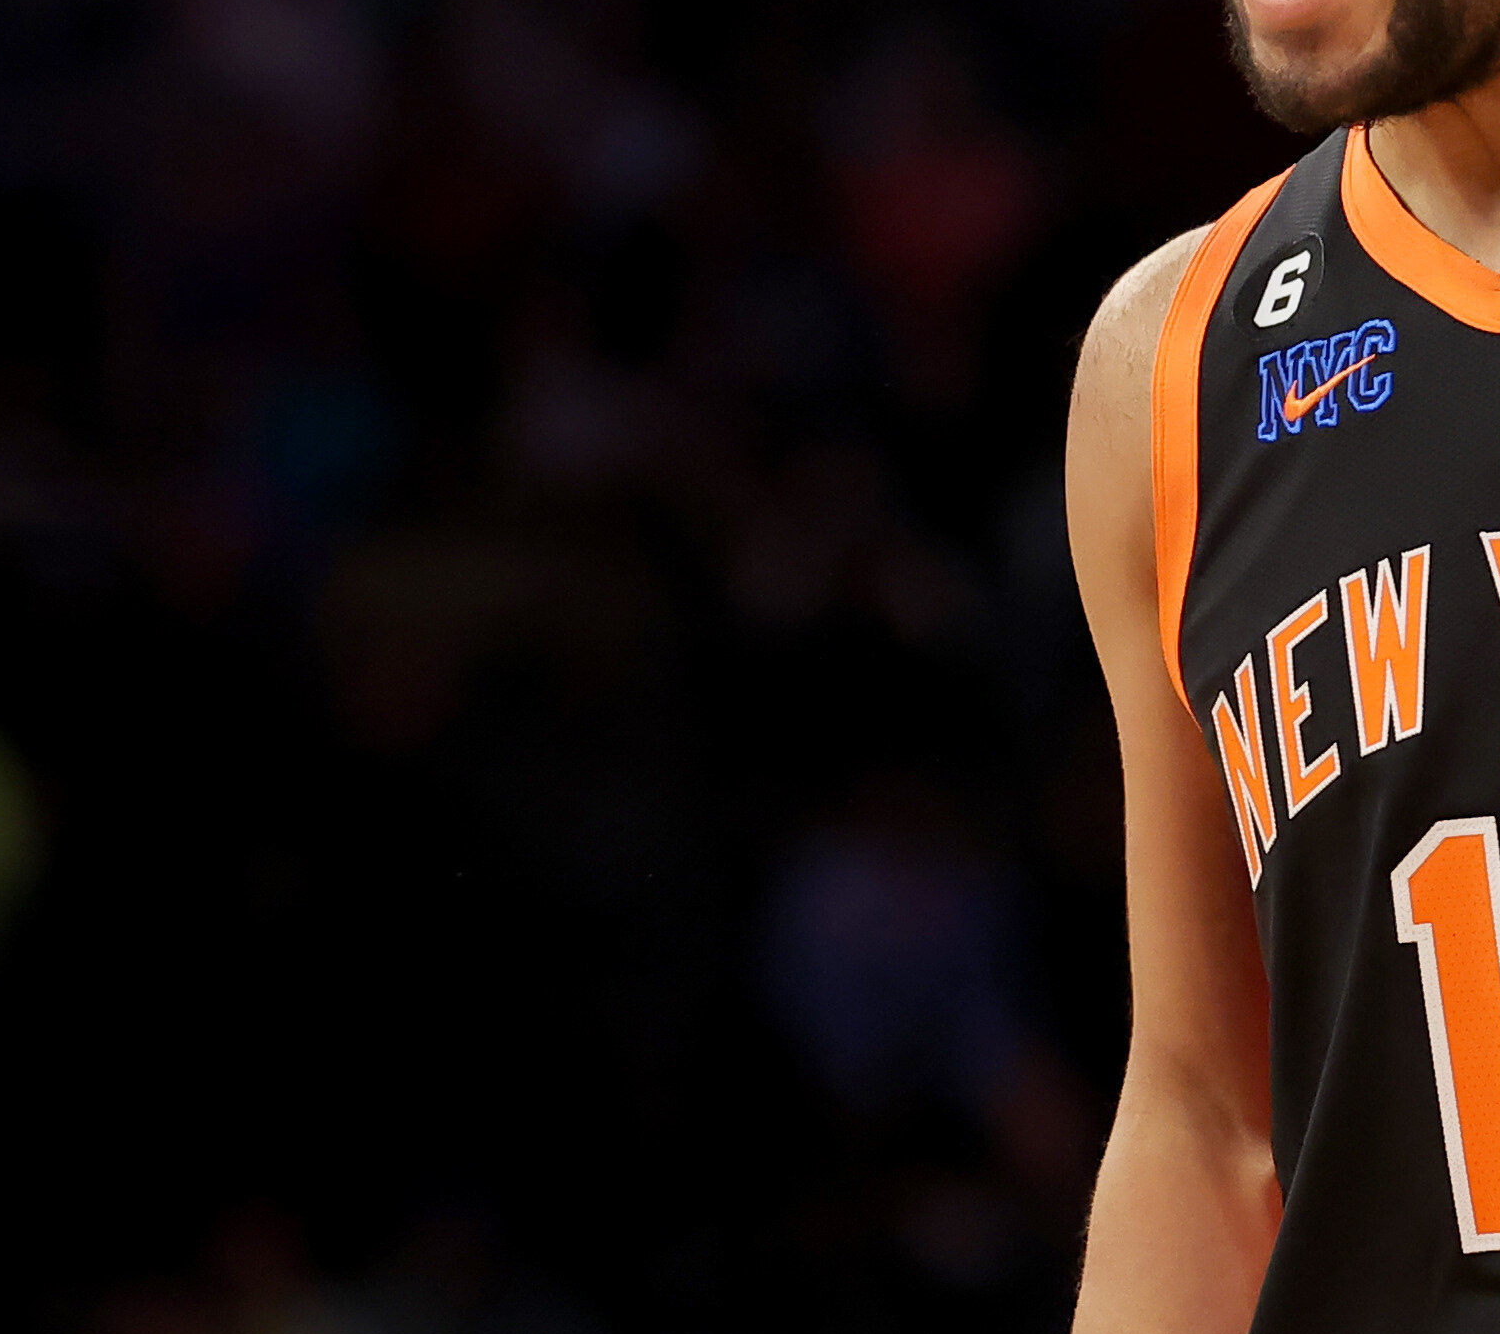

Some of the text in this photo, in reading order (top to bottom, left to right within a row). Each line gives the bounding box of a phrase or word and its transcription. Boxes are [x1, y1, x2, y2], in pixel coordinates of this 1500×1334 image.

[1253, 250, 1311, 328] 6
[1256, 317, 1398, 442] NYC
[1212, 544, 1431, 892] NEW
